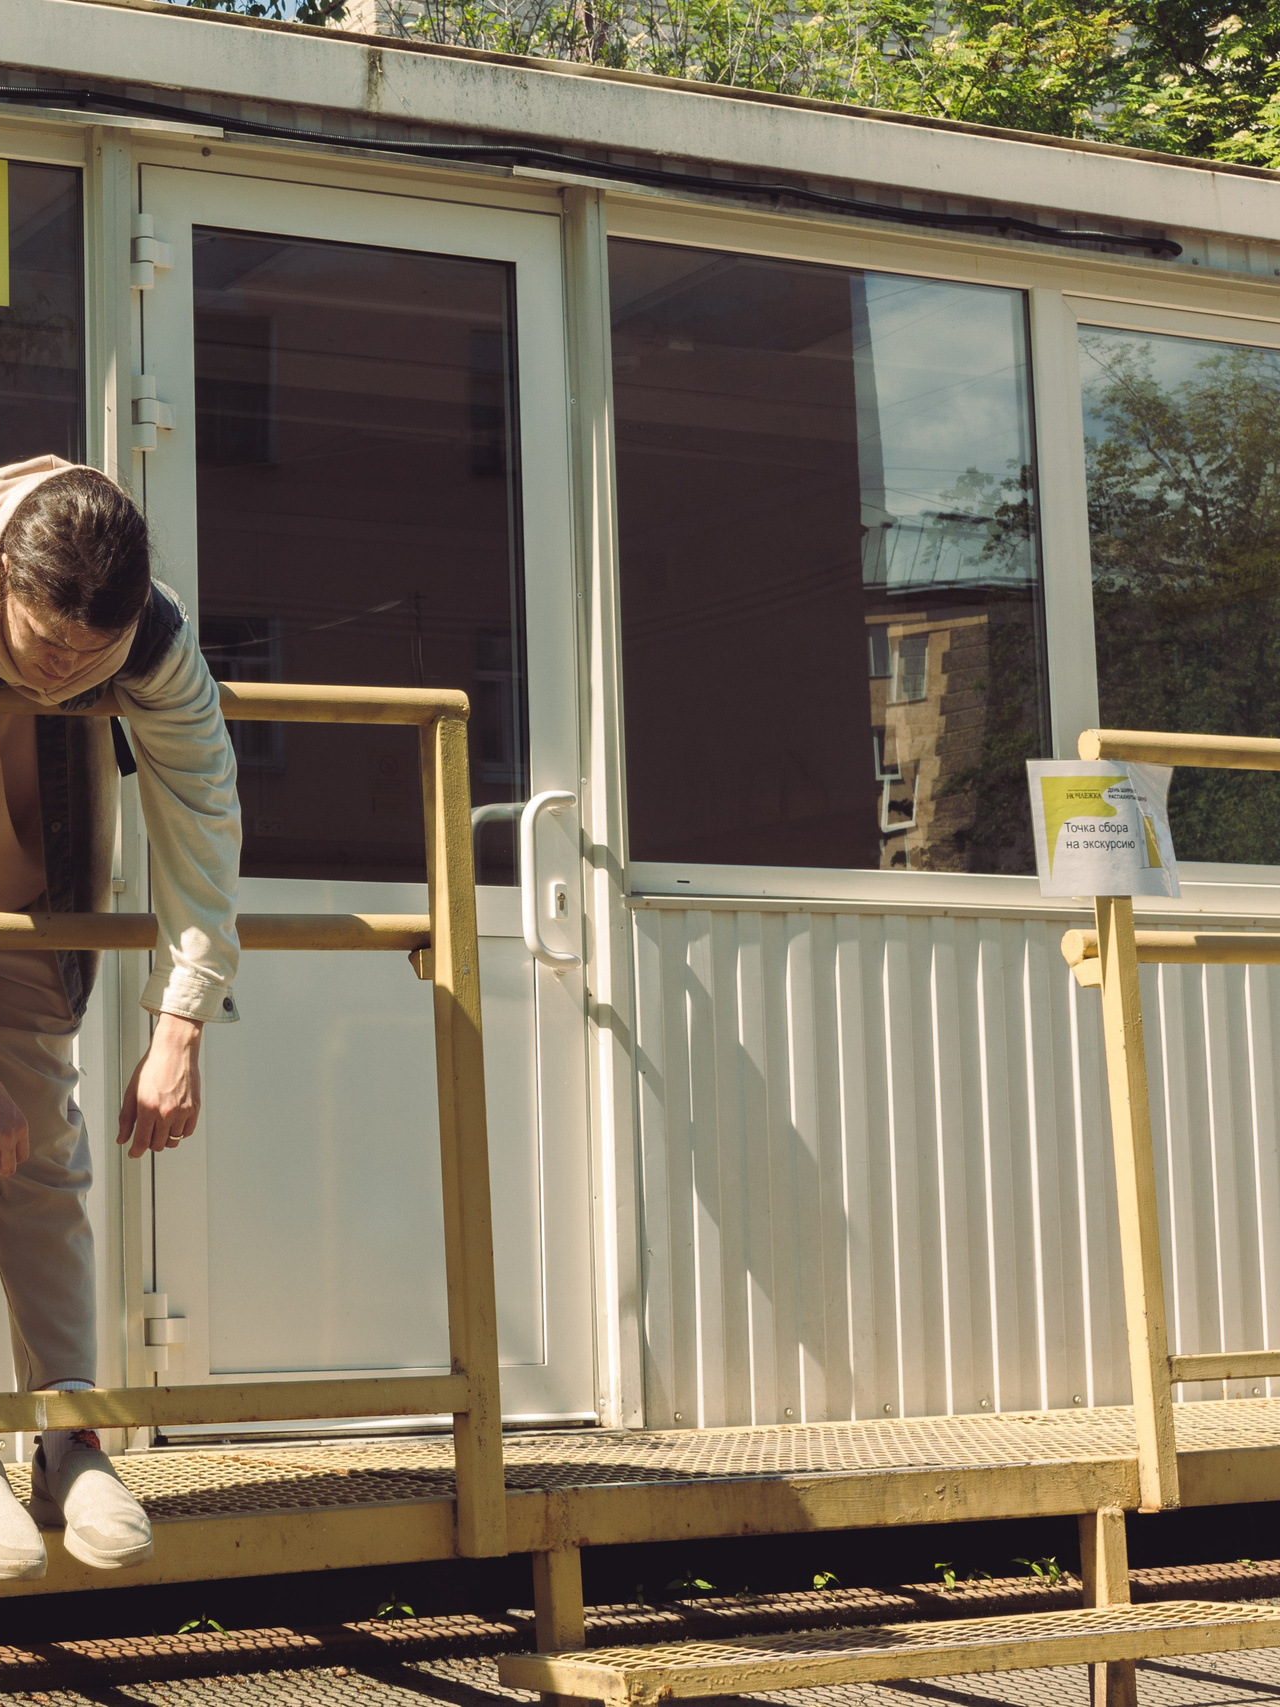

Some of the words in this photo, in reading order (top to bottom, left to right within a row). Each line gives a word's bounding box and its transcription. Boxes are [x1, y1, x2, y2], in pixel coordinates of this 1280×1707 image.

[1066, 792, 1102, 800] НОЧЛЕЖКА
[1064, 822, 1096, 834] Точка
[1099, 822, 1129, 835] сбора
[1066, 840, 1080, 849] на
[1083, 840, 1136, 851] экскурсию
